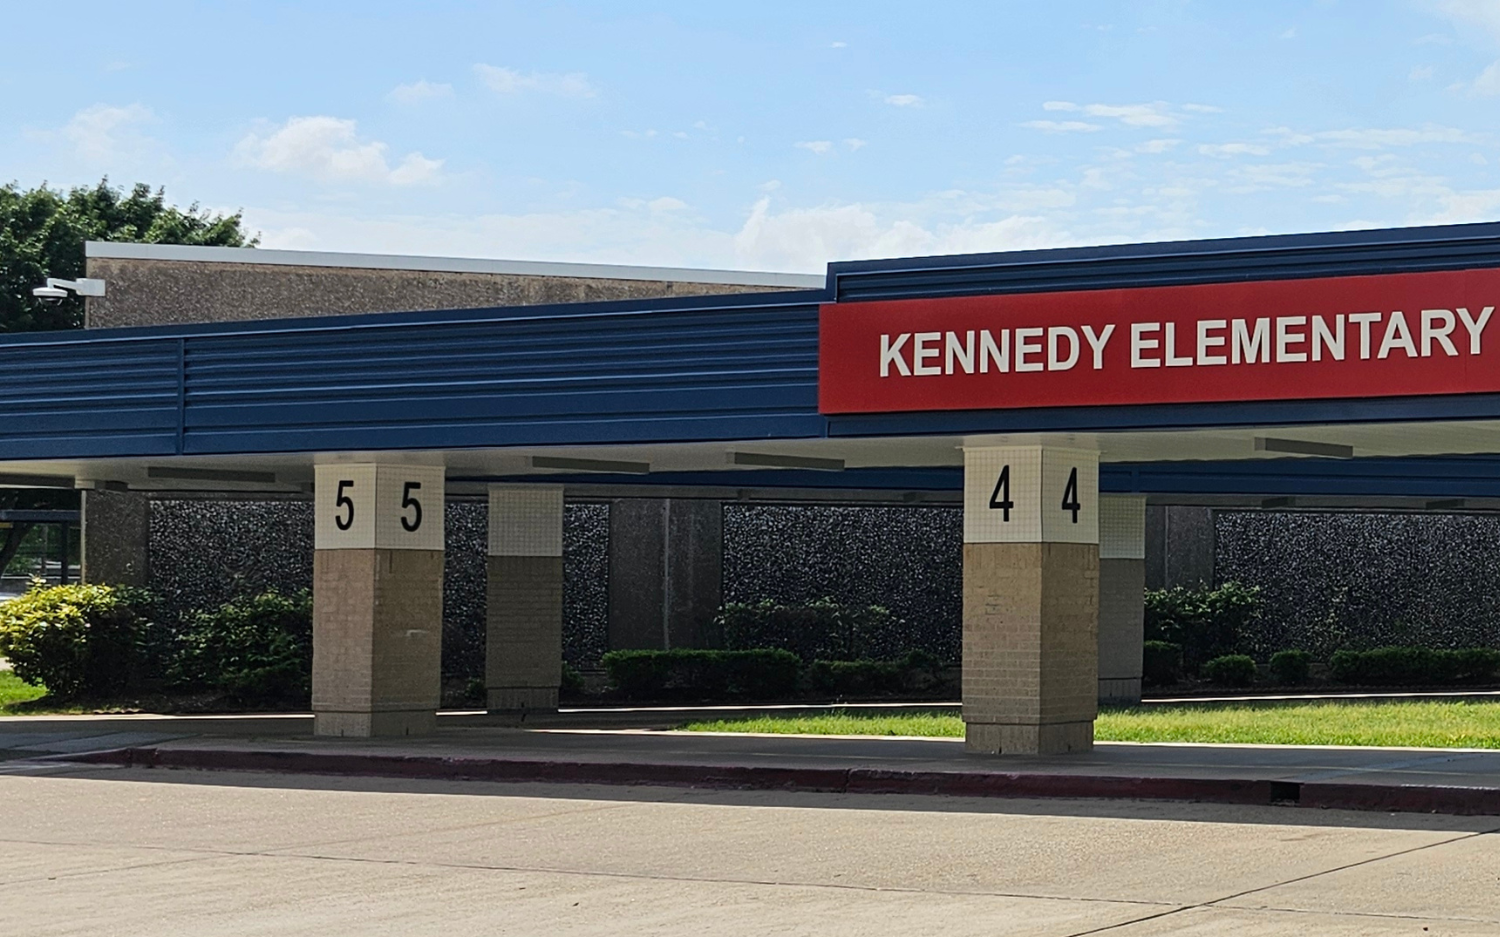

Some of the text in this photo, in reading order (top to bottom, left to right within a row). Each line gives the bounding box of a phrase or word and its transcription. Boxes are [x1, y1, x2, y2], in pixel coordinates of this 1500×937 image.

[879, 324, 1117, 378] KENNEDY
[1129, 306, 1495, 368] ELEMENTARY
[335, 480, 354, 531] 5
[400, 481, 422, 532] 5
[988, 464, 1014, 523] 4
[1062, 467, 1081, 524] 4
